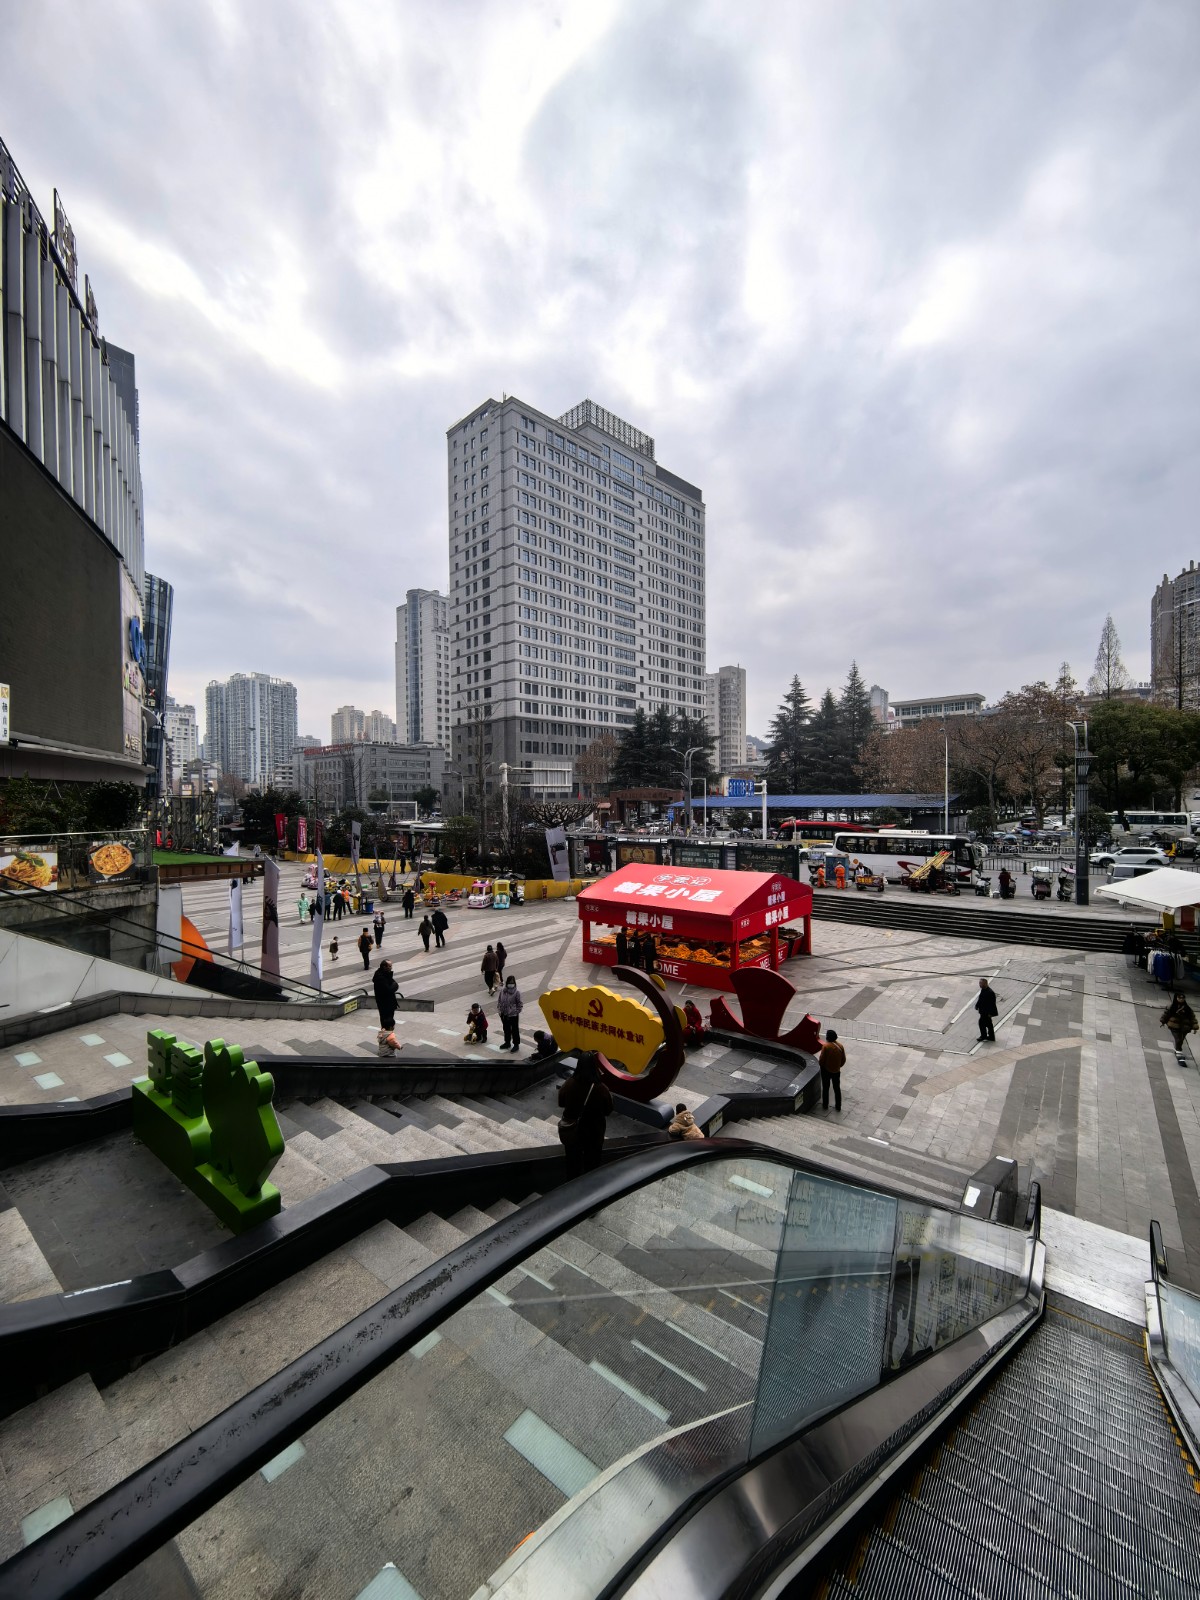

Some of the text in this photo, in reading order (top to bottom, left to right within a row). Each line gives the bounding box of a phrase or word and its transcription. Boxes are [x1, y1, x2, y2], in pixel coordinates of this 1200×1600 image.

[613, 881, 724, 902] 糖果小屋
[625, 910, 674, 930] 糖果小屋
